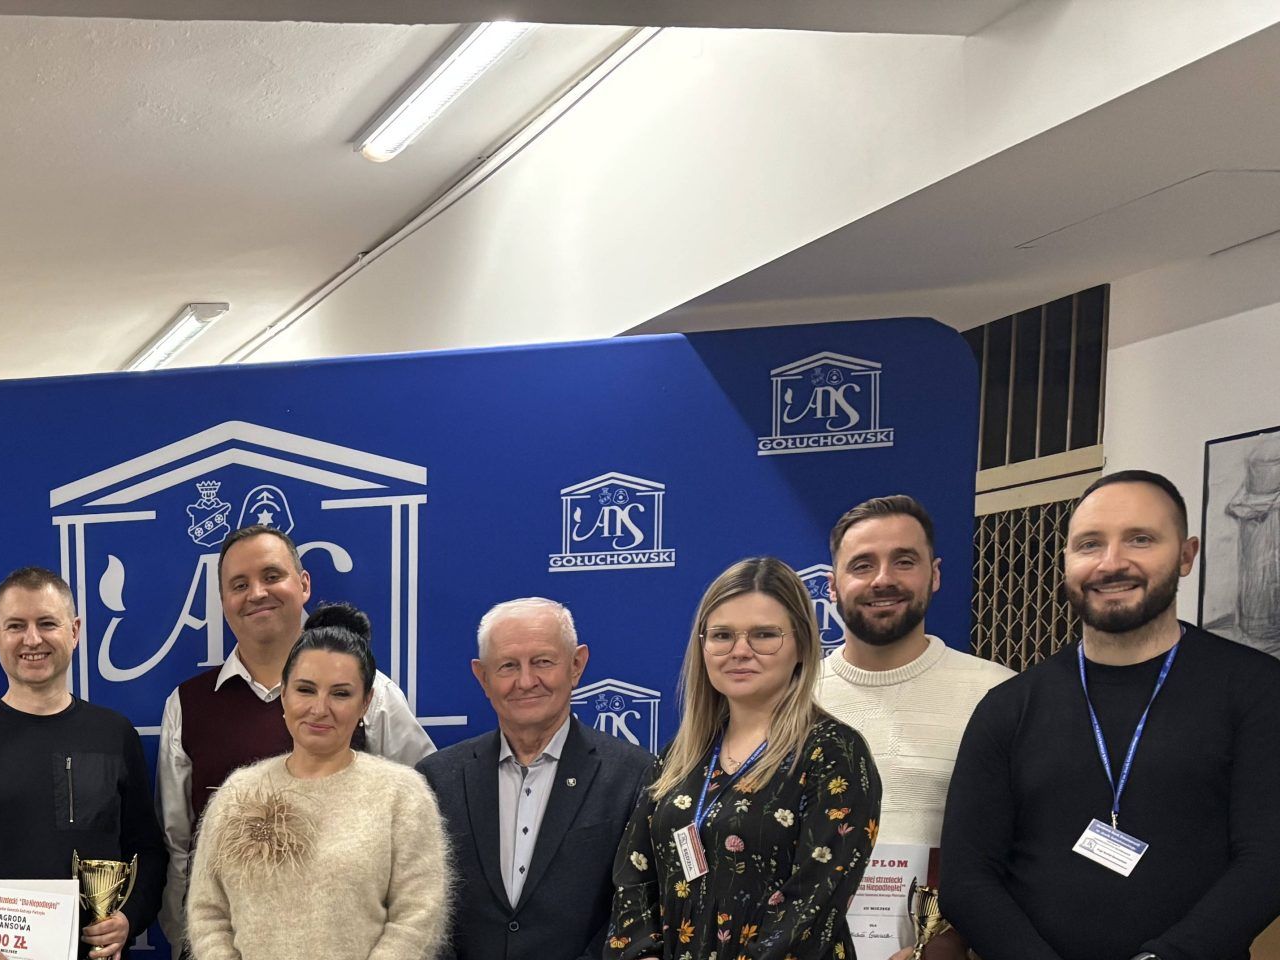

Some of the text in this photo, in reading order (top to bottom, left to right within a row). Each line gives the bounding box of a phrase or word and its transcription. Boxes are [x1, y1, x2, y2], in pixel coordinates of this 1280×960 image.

[758, 431, 894, 450] GOŁUCHOWSKI
[549, 551, 675, 567] GOŁUCHOWSKI
[871, 859, 909, 868] PLOM
[13, 935, 28, 950] ZŁ
